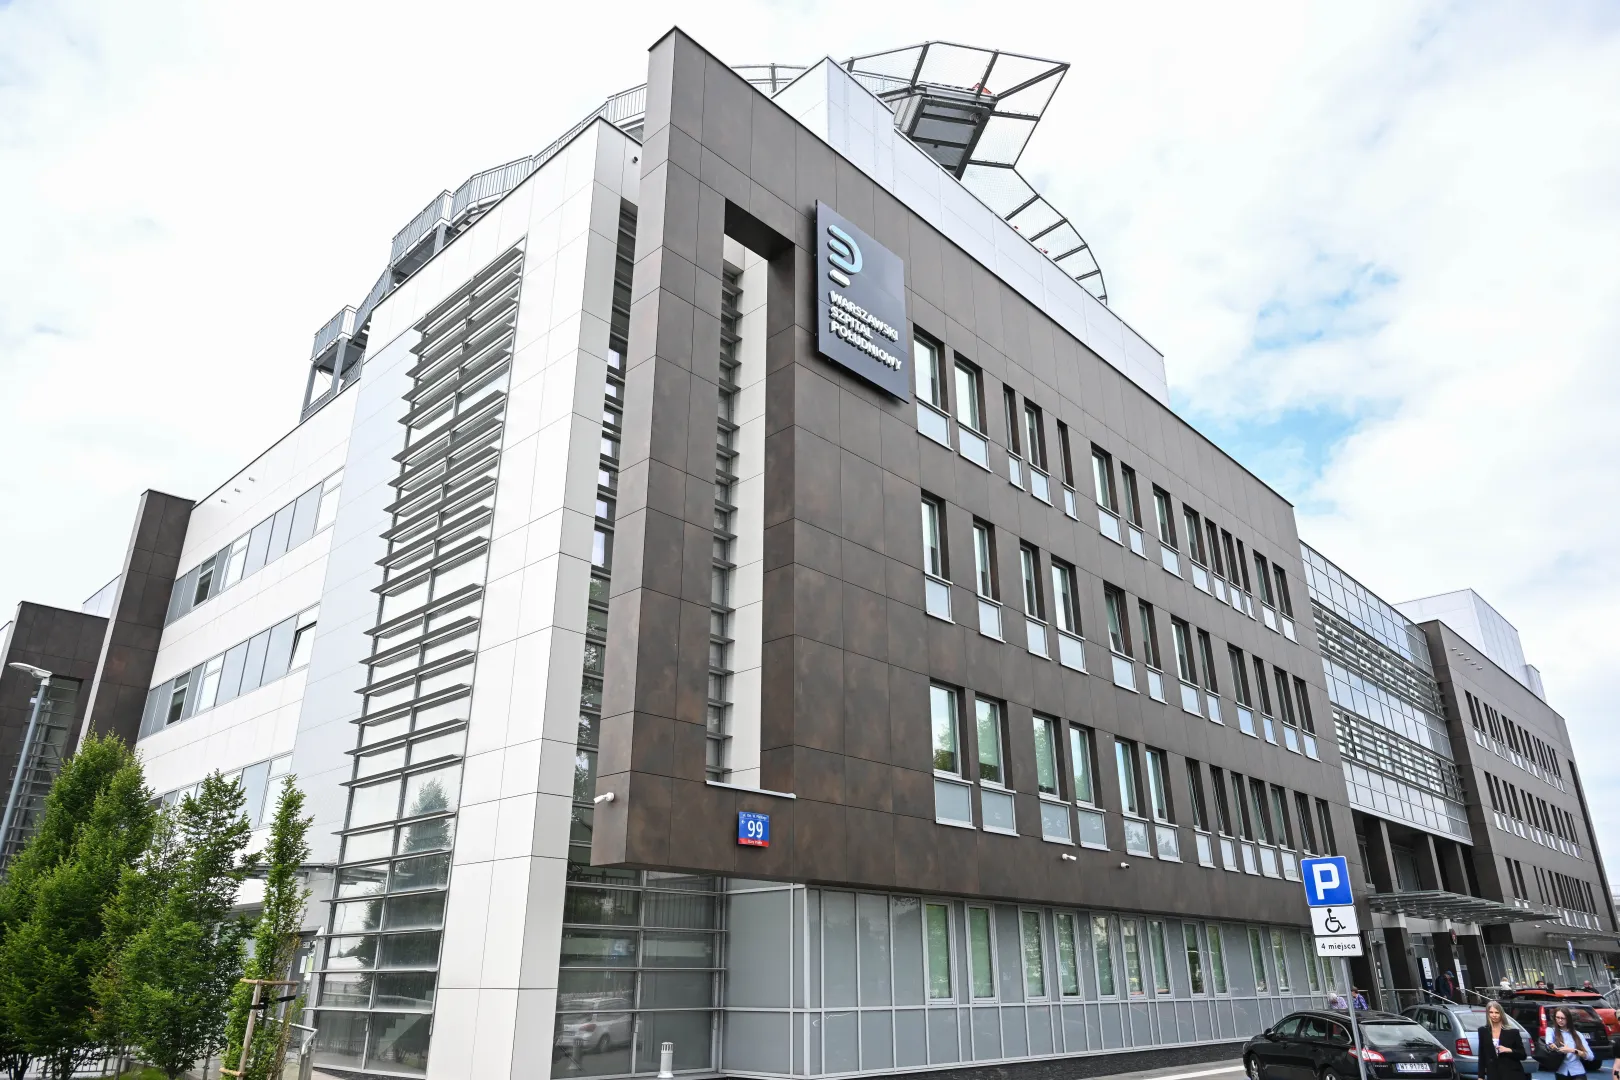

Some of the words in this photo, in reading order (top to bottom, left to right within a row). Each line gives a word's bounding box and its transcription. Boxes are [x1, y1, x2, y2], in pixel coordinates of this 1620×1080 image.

[829, 290, 899, 341] WARSZAWSKI
[829, 306, 874, 340] SZPITAL
[830, 320, 902, 370] POŁUDNIOWY
[747, 820, 763, 838] 99
[1312, 863, 1340, 900] P
[1328, 943, 1356, 951] miejsca
